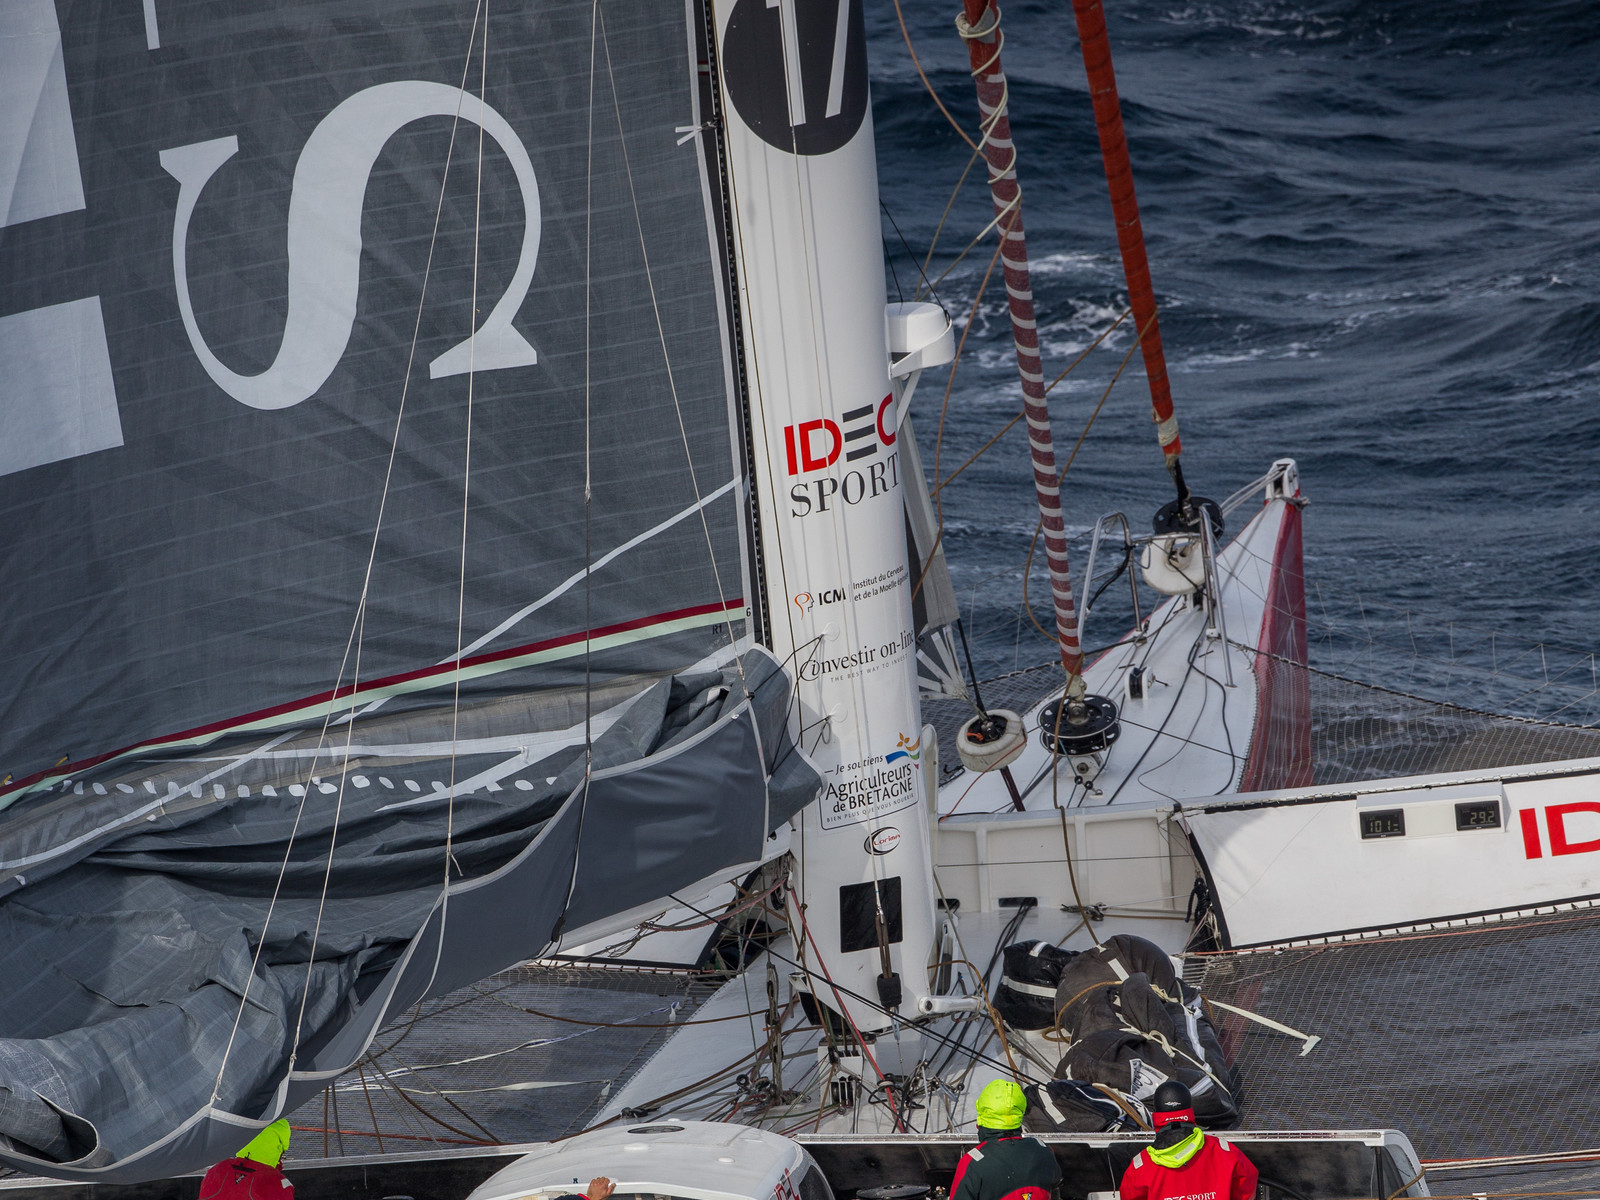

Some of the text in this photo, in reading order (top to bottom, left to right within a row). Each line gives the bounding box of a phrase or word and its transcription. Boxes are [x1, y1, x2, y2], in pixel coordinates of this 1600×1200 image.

[765, 0, 850, 127] 17
[143, 0, 542, 411] S
[784, 392, 896, 476] IDEC
[790, 452, 899, 518] SPORT
[852, 575, 878, 590] Institut
[878, 572, 887, 582] du
[818, 587, 847, 606] ICM
[854, 594, 862, 602] et
[863, 590, 872, 600] de
[872, 585, 879, 596] la
[745, 607, 751, 617] 6
[712, 623, 722, 635] R1
[830, 675, 844, 683] THE
[847, 670, 864, 680] BEST
[866, 665, 880, 674] WAY
[882, 661, 891, 669] TO
[835, 755, 884, 776] Je soutiens
[825, 763, 912, 802] Agriculteurs
[832, 777, 913, 813] de BRETAGNE
[826, 815, 842, 823] BIEN
[844, 811, 860, 820] PLUS
[877, 802, 892, 811] VOUS
